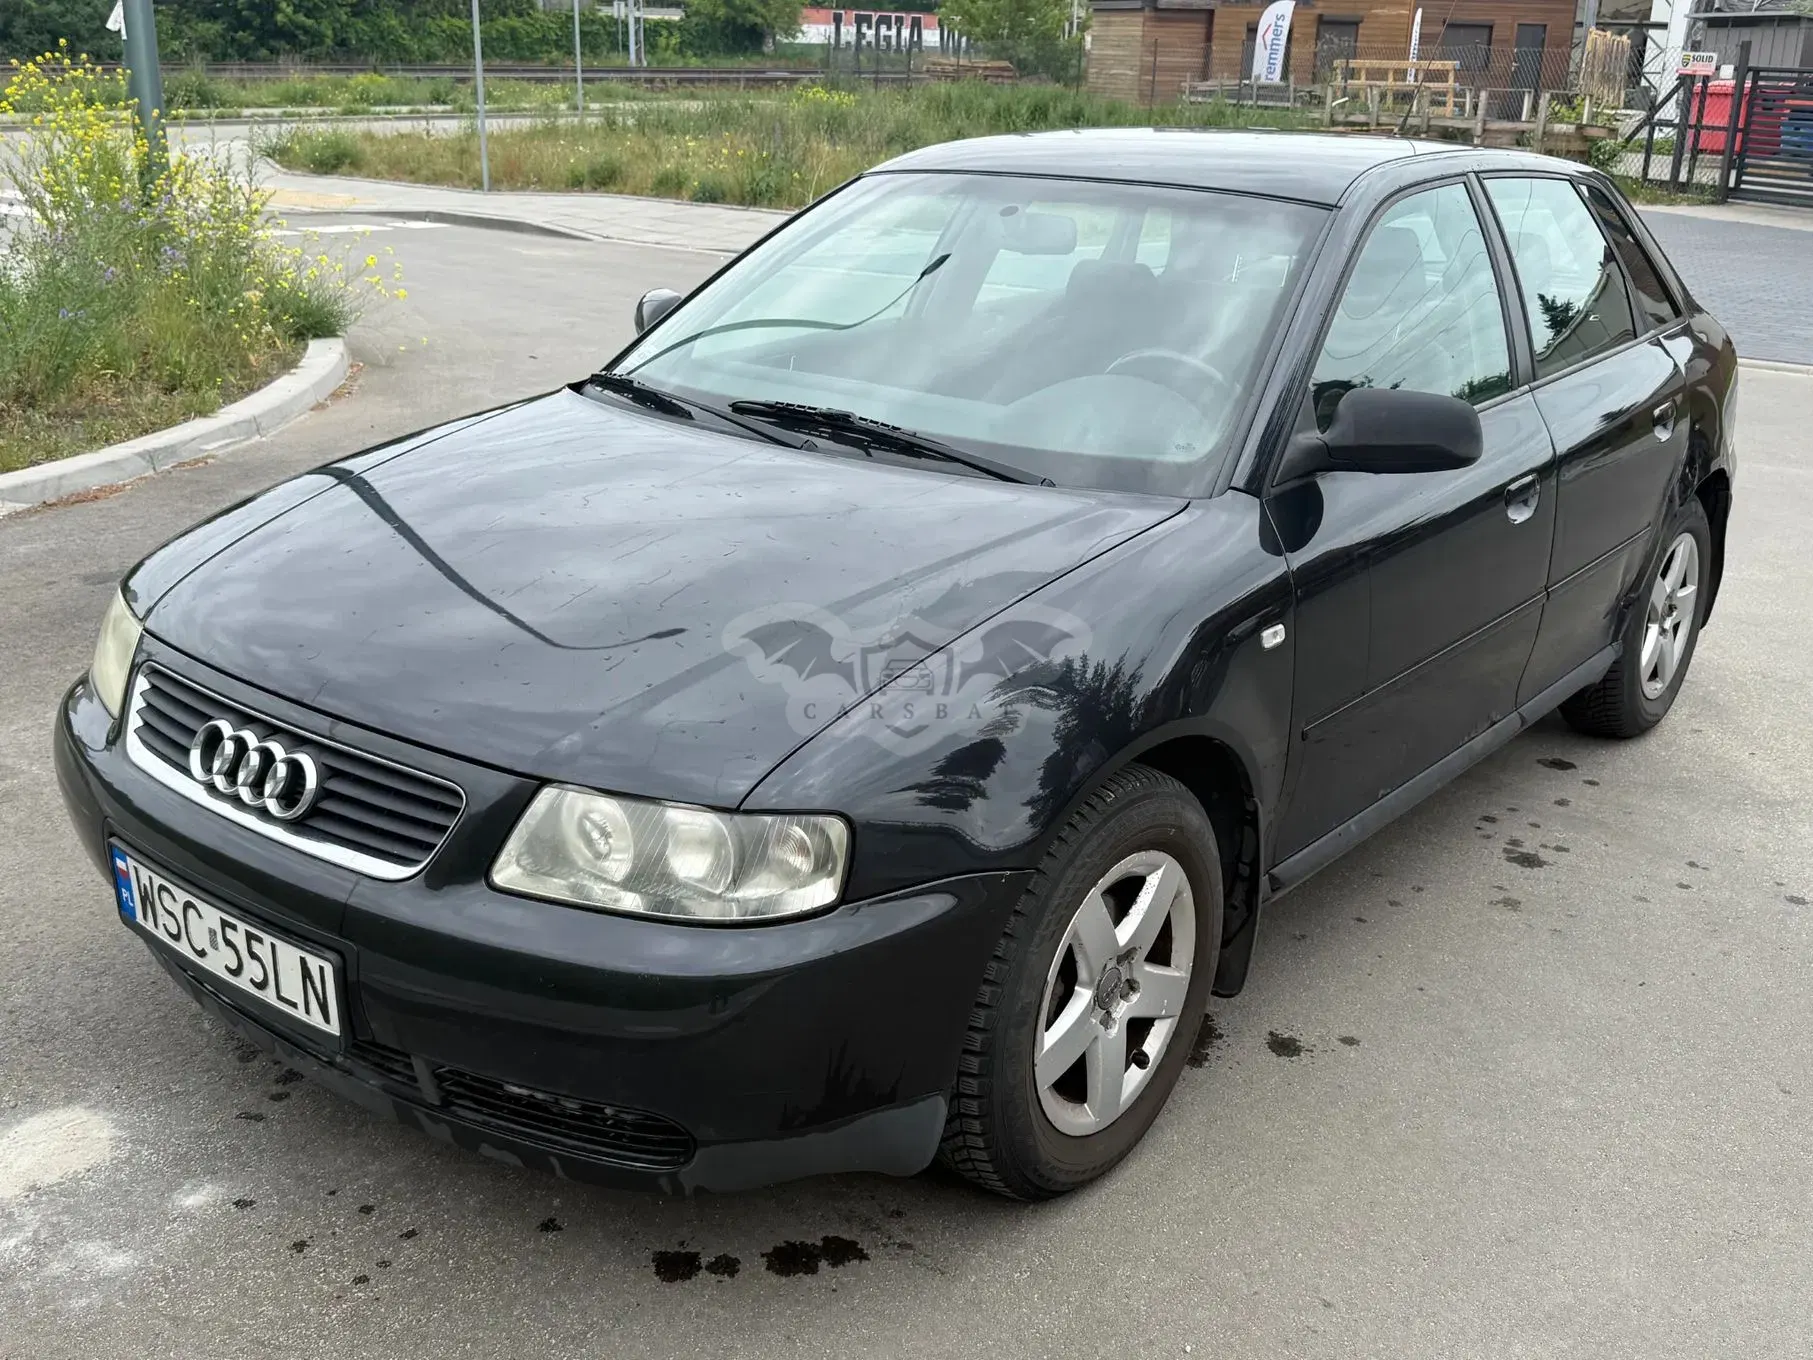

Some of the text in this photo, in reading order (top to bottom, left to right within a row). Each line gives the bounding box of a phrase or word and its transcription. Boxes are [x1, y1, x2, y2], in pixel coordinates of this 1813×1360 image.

[832, 12, 924, 52] LEGIA
[1265, 13, 1286, 82] remmers
[1691, 54, 1714, 63] SOLID
[121, 887, 134, 907] PL
[133, 864, 331, 1025] WSC 55LN
